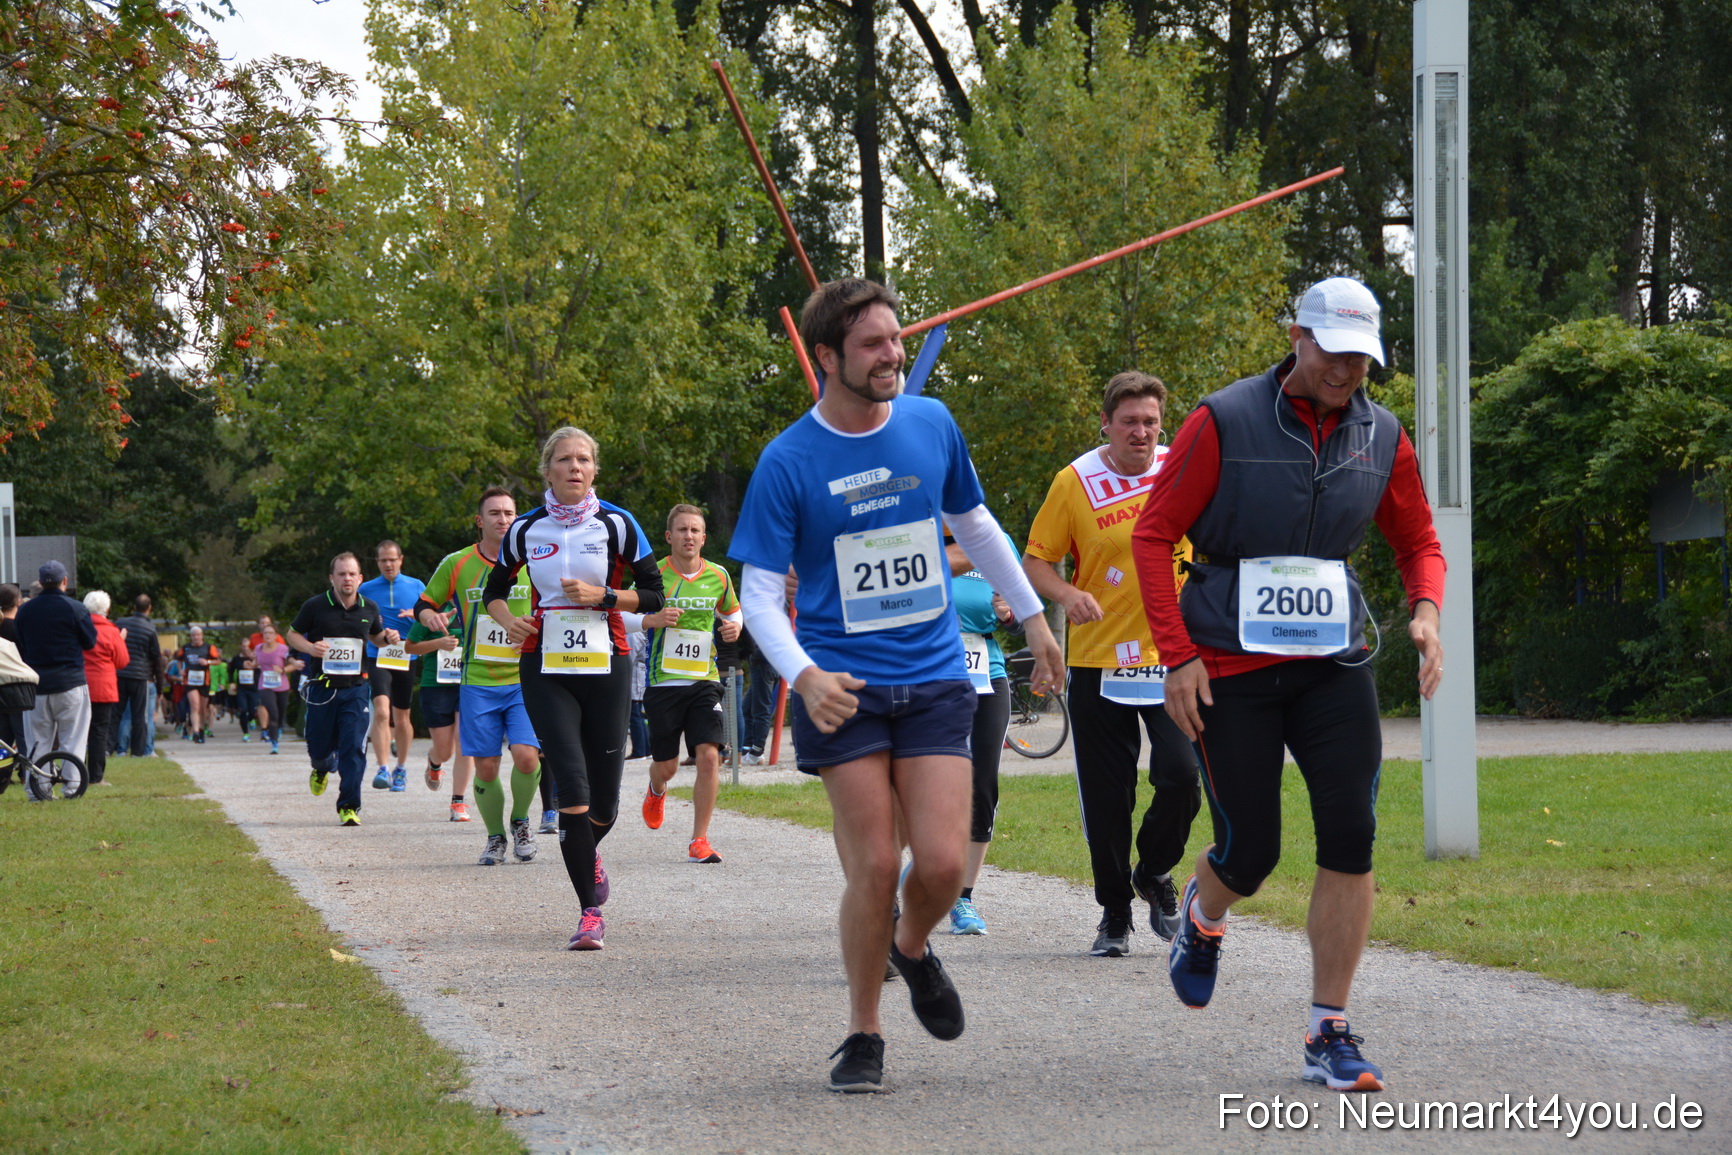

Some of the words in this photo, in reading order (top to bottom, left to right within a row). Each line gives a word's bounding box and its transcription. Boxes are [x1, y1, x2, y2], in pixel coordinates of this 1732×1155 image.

[843, 470, 882, 488] HEUTE
[860, 478, 912, 498] MORGEN
[851, 495, 900, 516] BEWEGEN
[1096, 503, 1143, 530] MAX
[532, 545, 551, 555] tkn
[853, 553, 928, 592] 2150
[665, 597, 718, 610] BOCK
[880, 597, 913, 611] Marco
[1256, 586, 1333, 616] 2600
[563, 629, 588, 649] 34
[1272, 626, 1318, 638] Clemens
[328, 649, 355, 660] 2251
[385, 648, 403, 658] 302
[675, 643, 700, 658] 419
[562, 655, 589, 663] Martina
